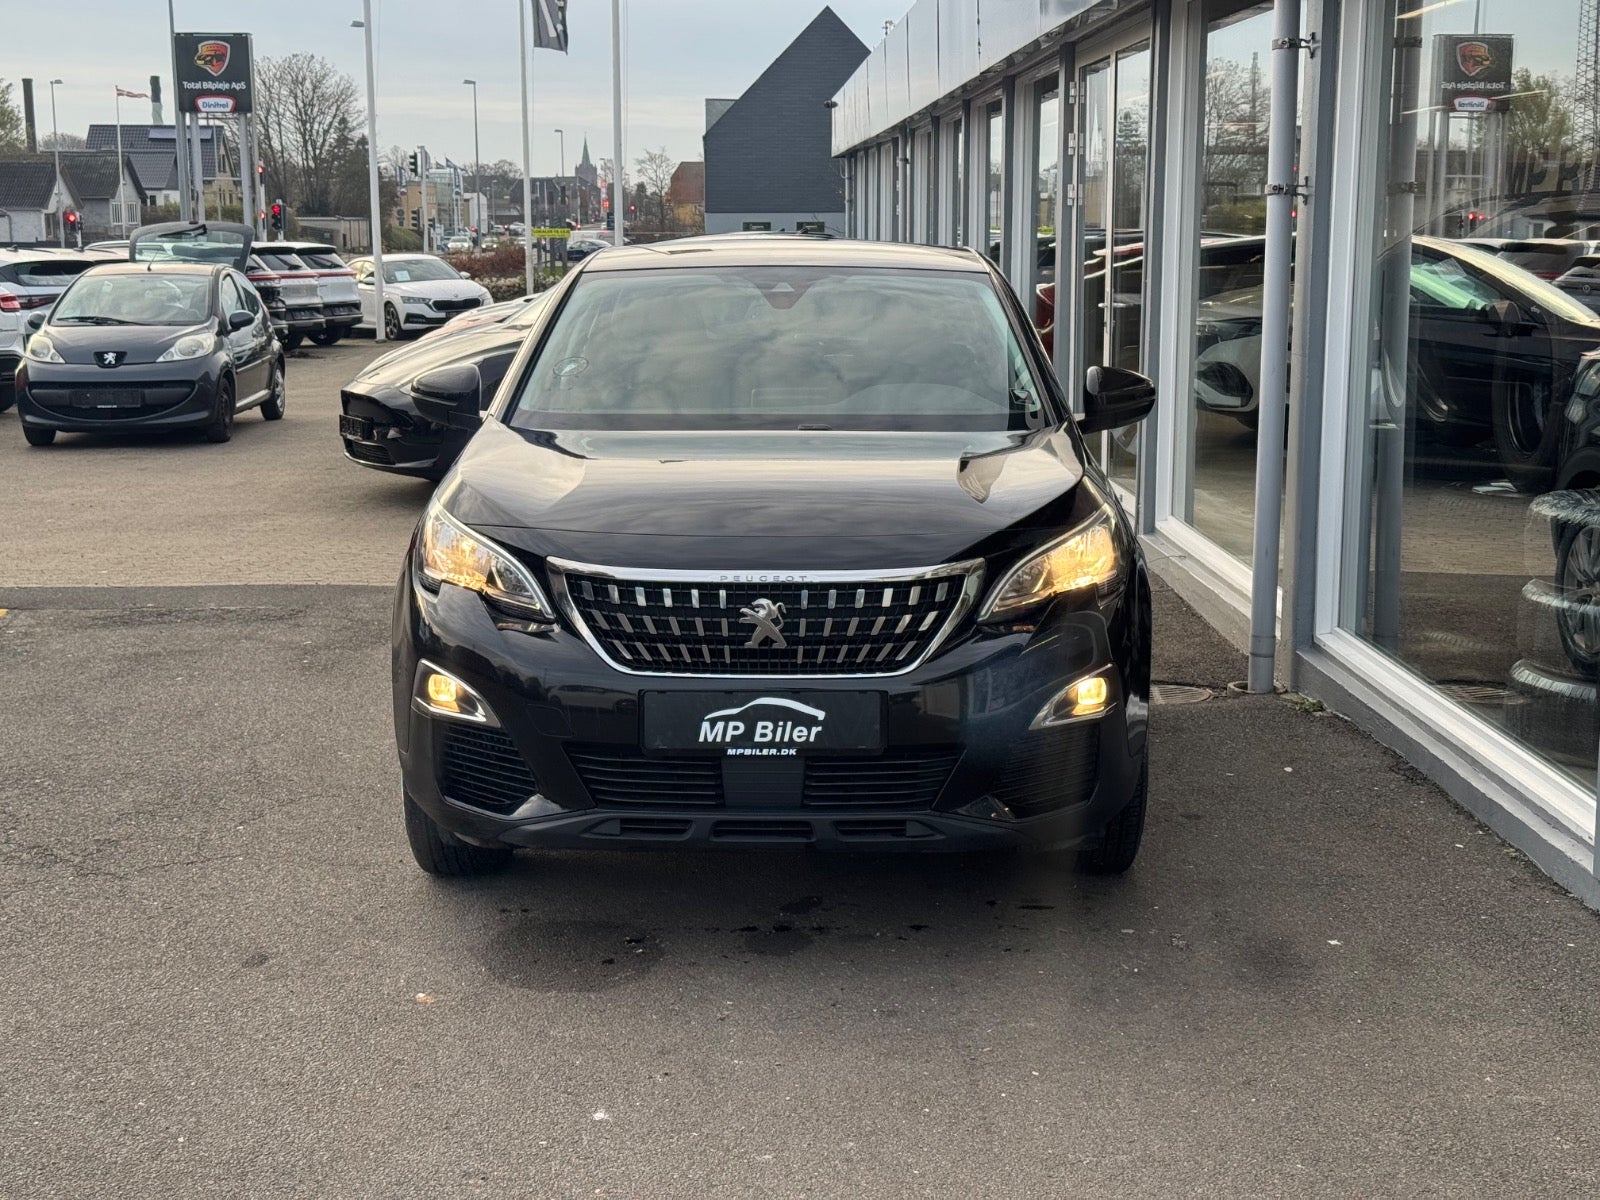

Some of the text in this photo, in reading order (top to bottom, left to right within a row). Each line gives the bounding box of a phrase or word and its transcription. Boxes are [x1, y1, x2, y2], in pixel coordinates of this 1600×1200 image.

[183, 81, 246, 91] Total Bilpleje ApS
[202, 101, 229, 109] Dinitrol
[698, 721, 823, 743] MP Biler
[727, 748, 798, 756] MPBILER.DK
